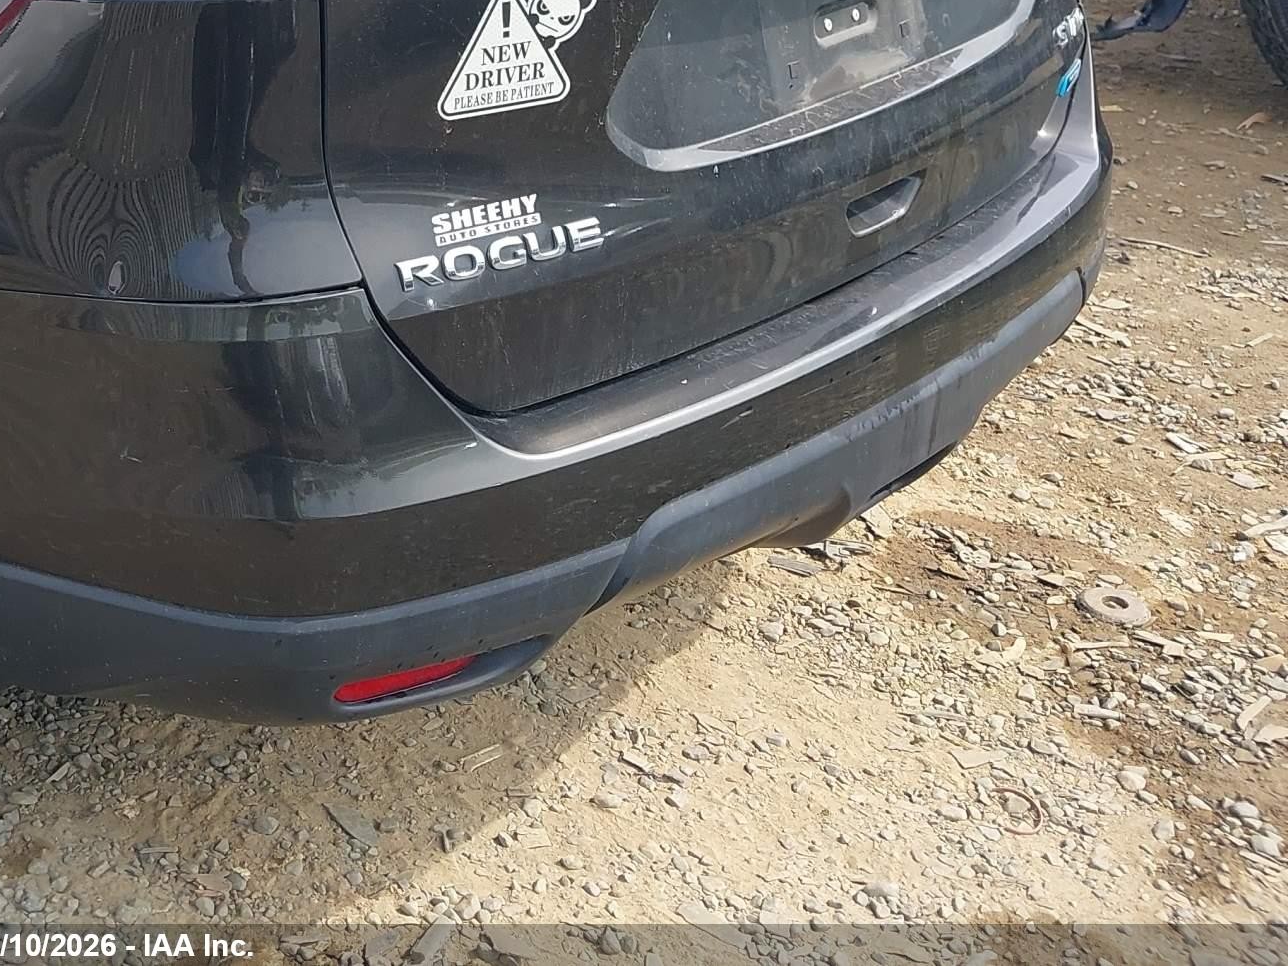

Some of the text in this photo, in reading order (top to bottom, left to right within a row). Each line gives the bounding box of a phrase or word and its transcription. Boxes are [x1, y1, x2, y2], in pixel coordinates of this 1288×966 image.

[481, 41, 532, 66] NEW
[464, 62, 545, 91] DRIVER
[454, 82, 555, 110] PLEASE BE PATIENT
[431, 193, 538, 234] SHEEHY
[439, 215, 539, 244] AUTO STORES
[394, 217, 605, 292] ROGUE
